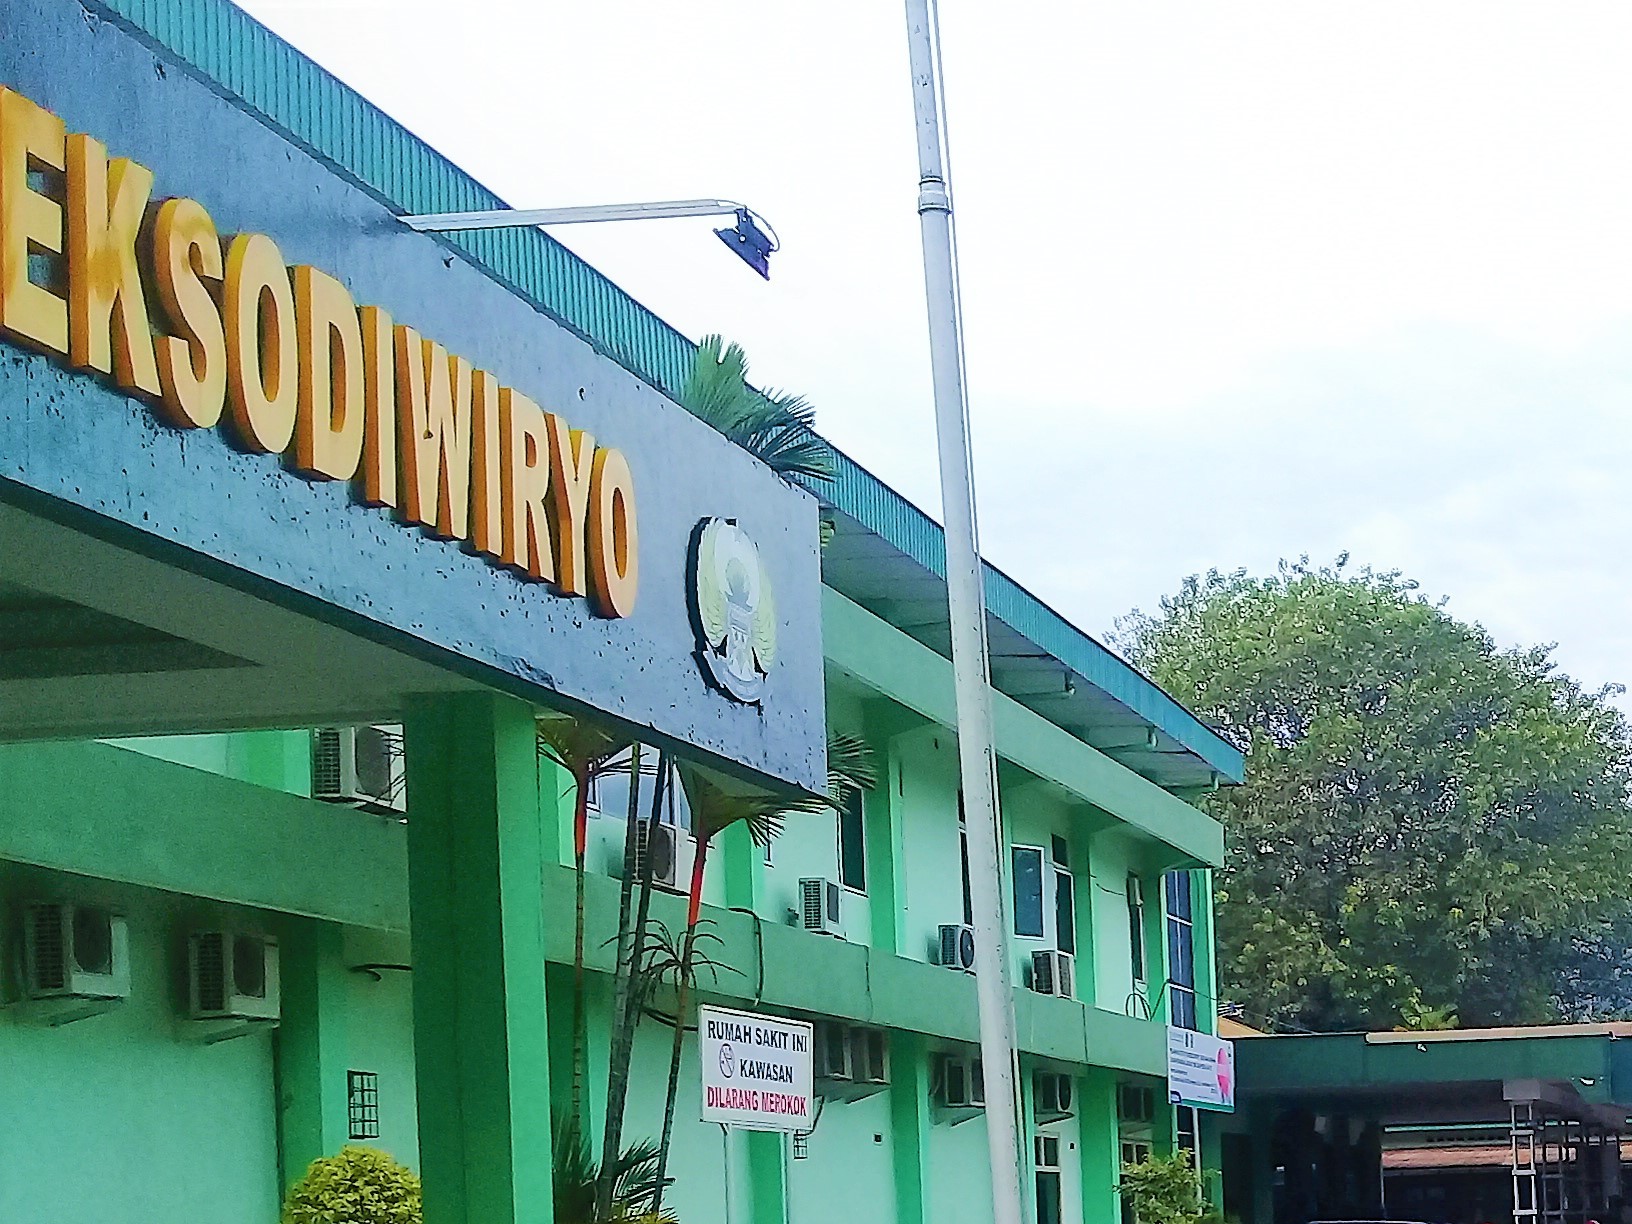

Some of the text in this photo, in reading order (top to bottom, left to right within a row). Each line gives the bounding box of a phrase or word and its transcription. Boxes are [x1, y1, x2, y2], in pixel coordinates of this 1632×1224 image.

[0, 85, 639, 619] EKSODIWIRYO
[707, 1020, 808, 1053] RUMAH SAKIT INI
[740, 1058, 793, 1084] KAWASAN
[707, 1086, 807, 1117] DILARANG MEROKOK
